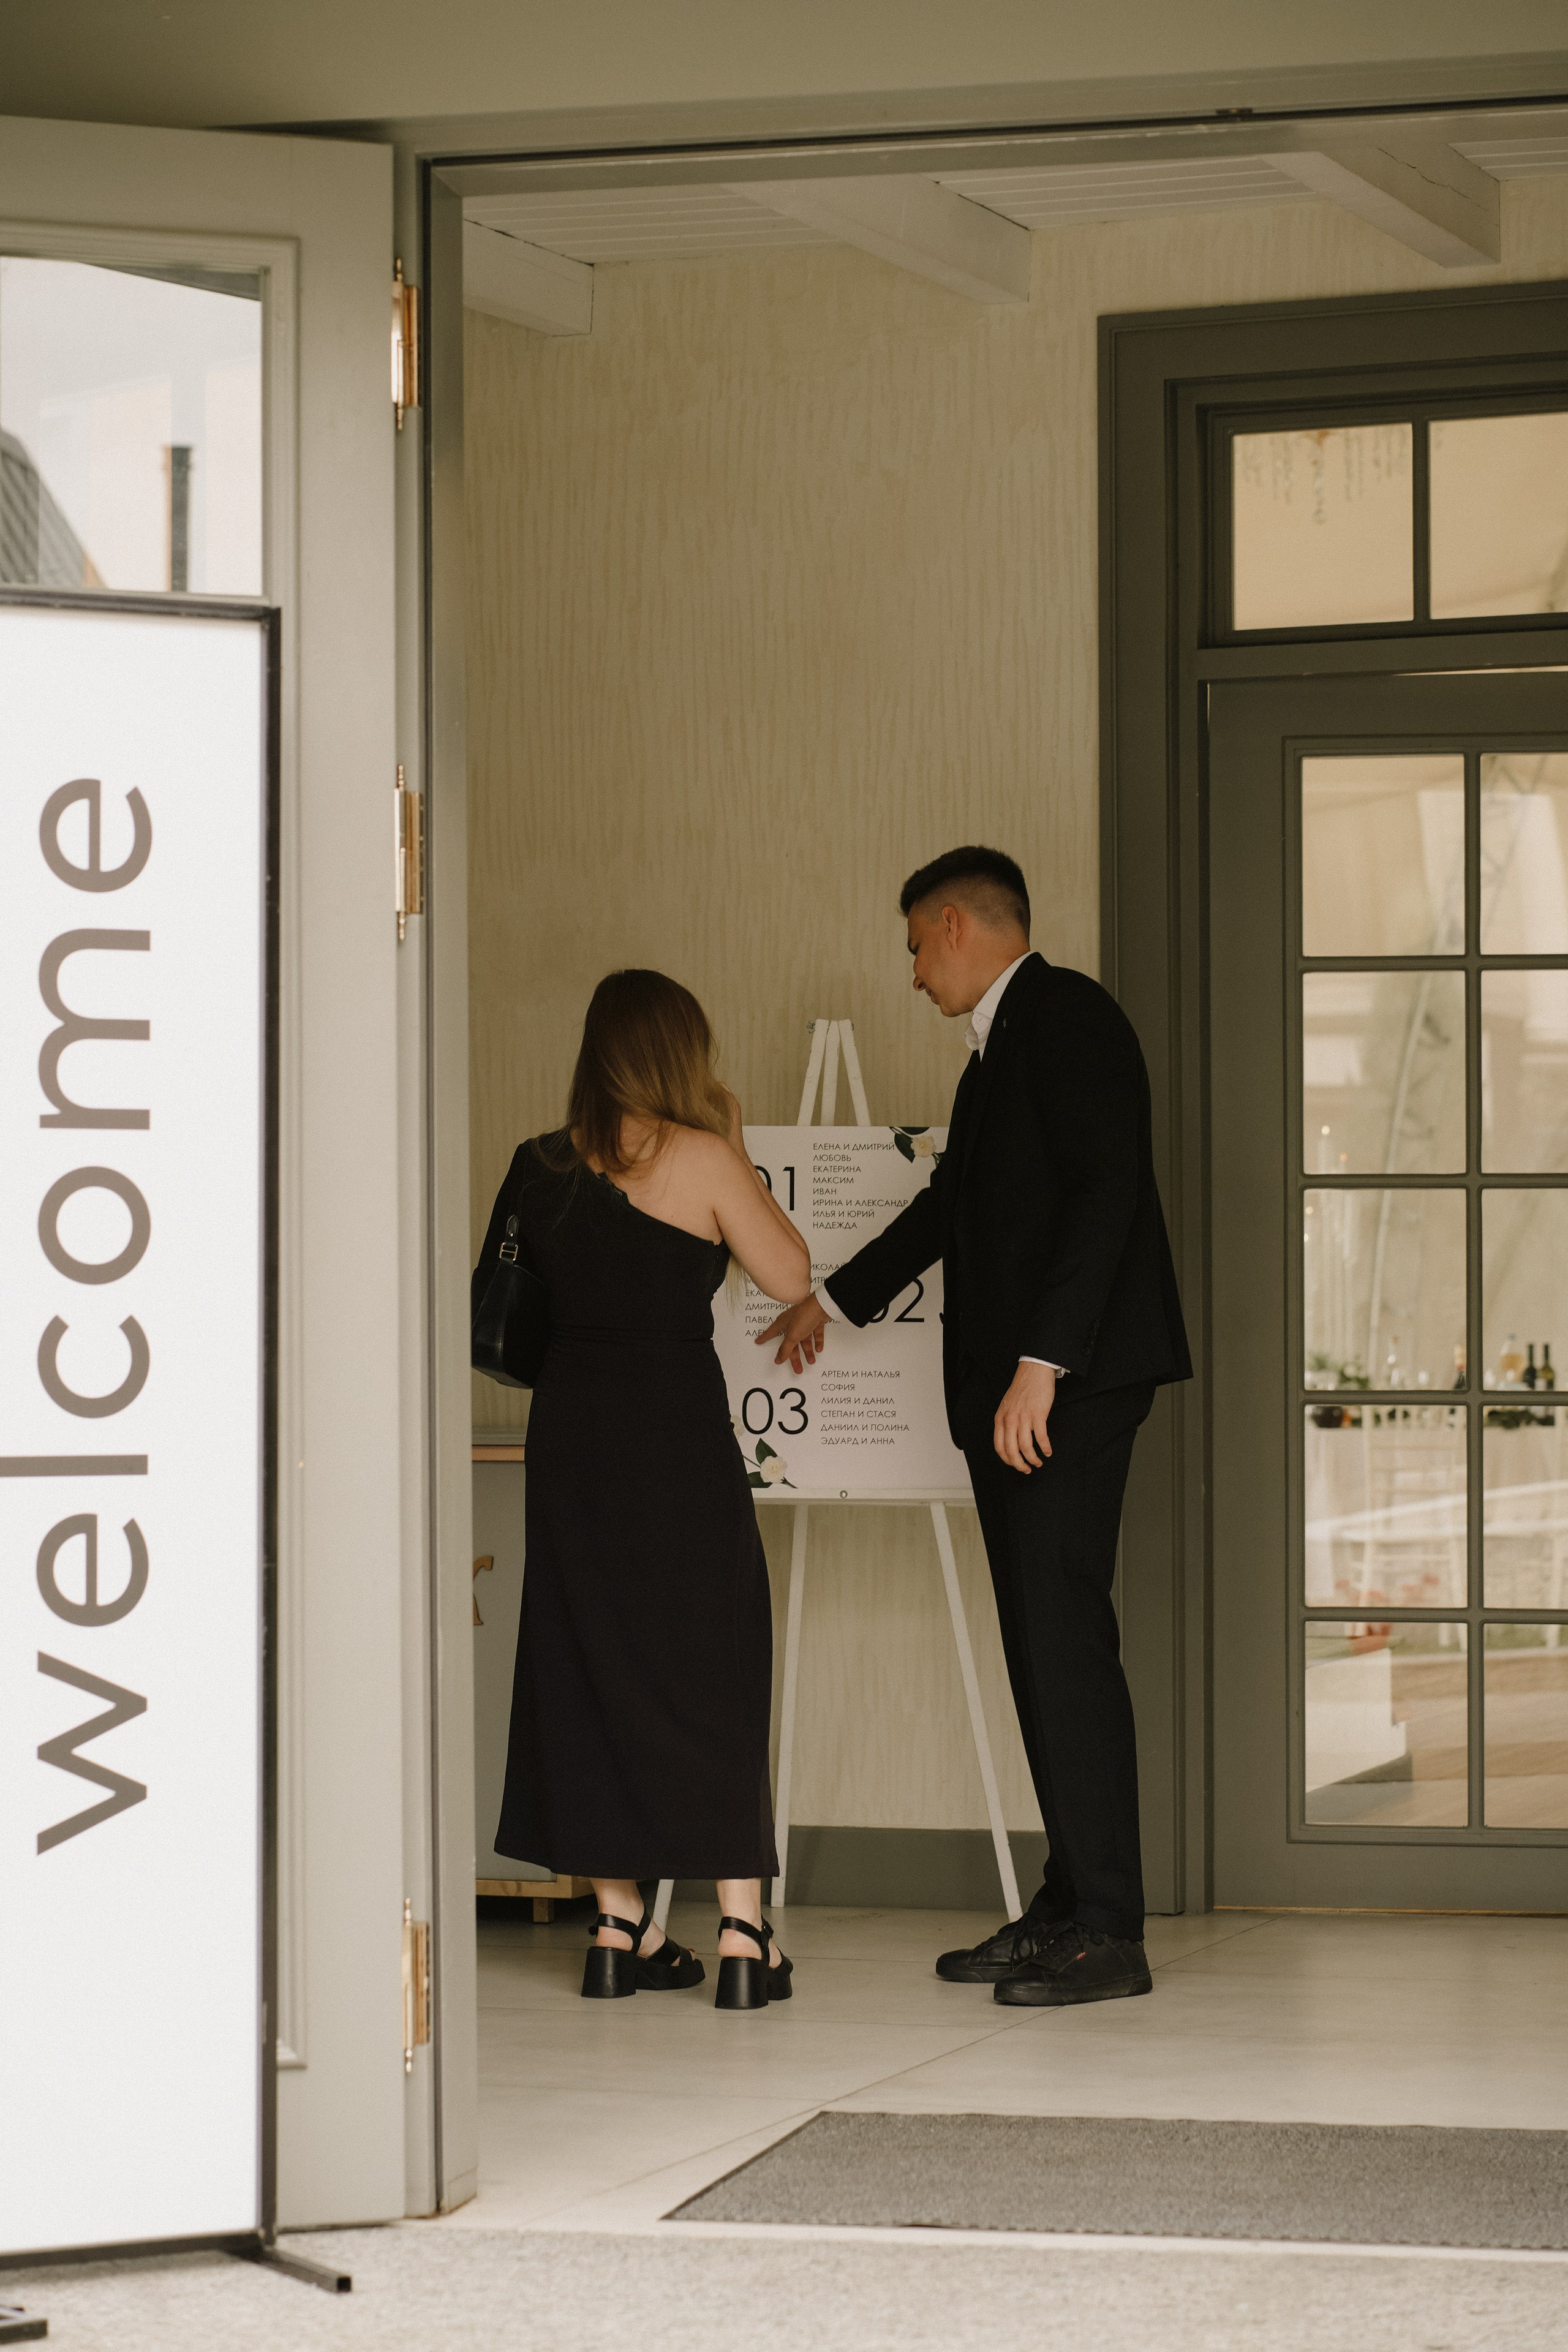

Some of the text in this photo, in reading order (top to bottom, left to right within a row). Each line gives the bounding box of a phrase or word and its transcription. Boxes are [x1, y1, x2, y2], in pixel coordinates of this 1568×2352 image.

[851, 1142, 895, 1151] ДМИТРИЙ
[847, 1208, 875, 1218] ЮРИЙ
[813, 1221, 858, 1230] НАДЕЖДА
[0, 779, 152, 1855] welcome
[742, 1387, 809, 1435] 03
